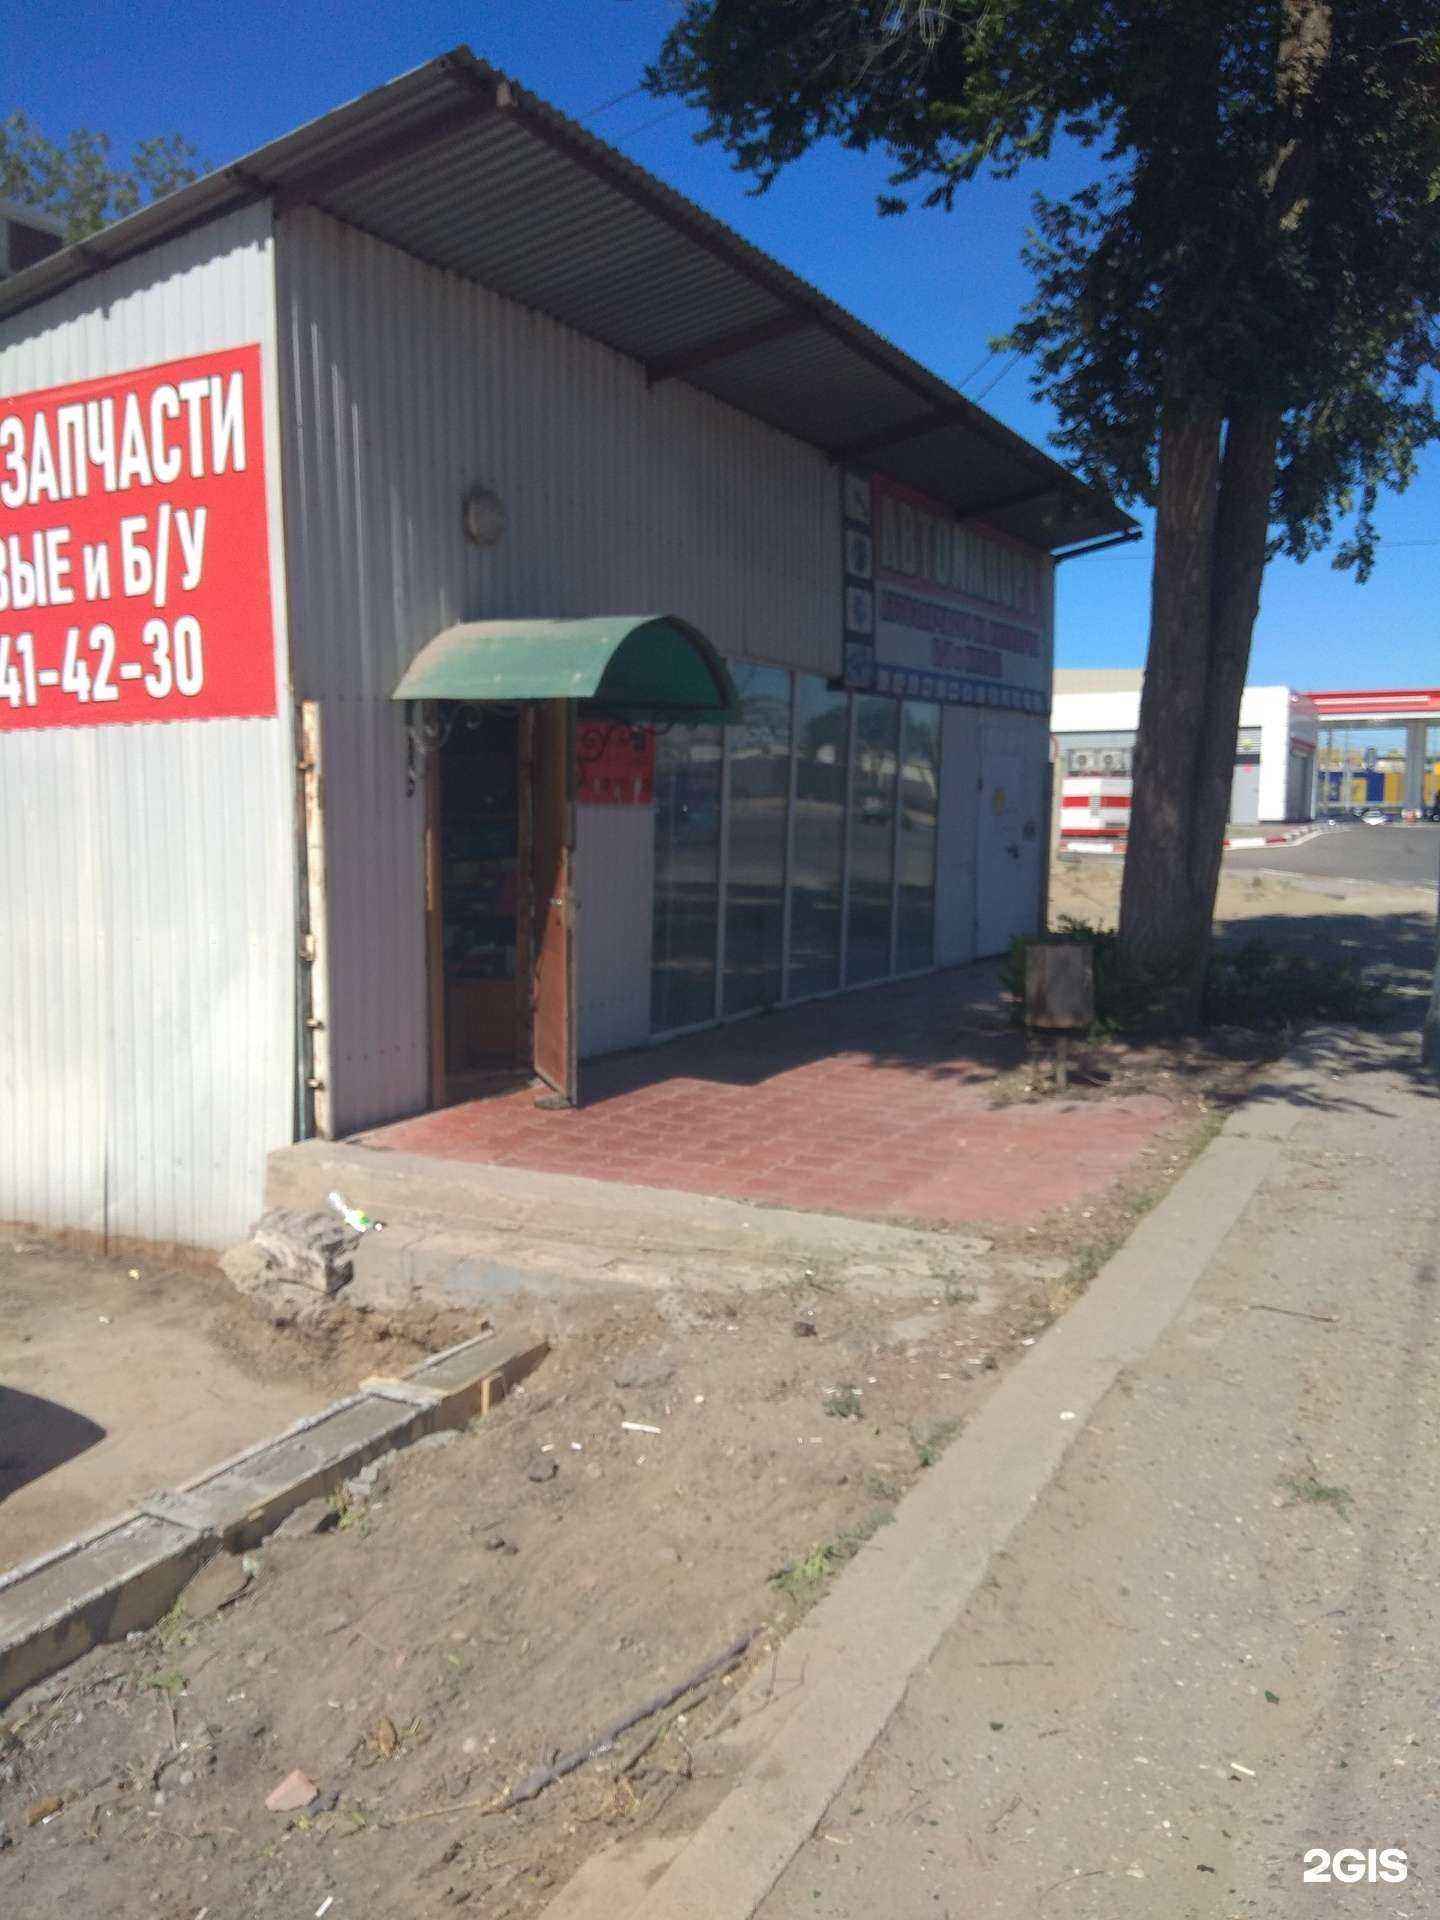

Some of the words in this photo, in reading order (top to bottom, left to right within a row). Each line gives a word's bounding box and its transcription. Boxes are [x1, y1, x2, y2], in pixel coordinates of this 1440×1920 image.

[1, 371, 247, 509] ЗАПЧАСТИ
[83, 542, 111, 602] и
[120, 502, 207, 607] Б/У
[0, 614, 205, 708] 41-42-30
